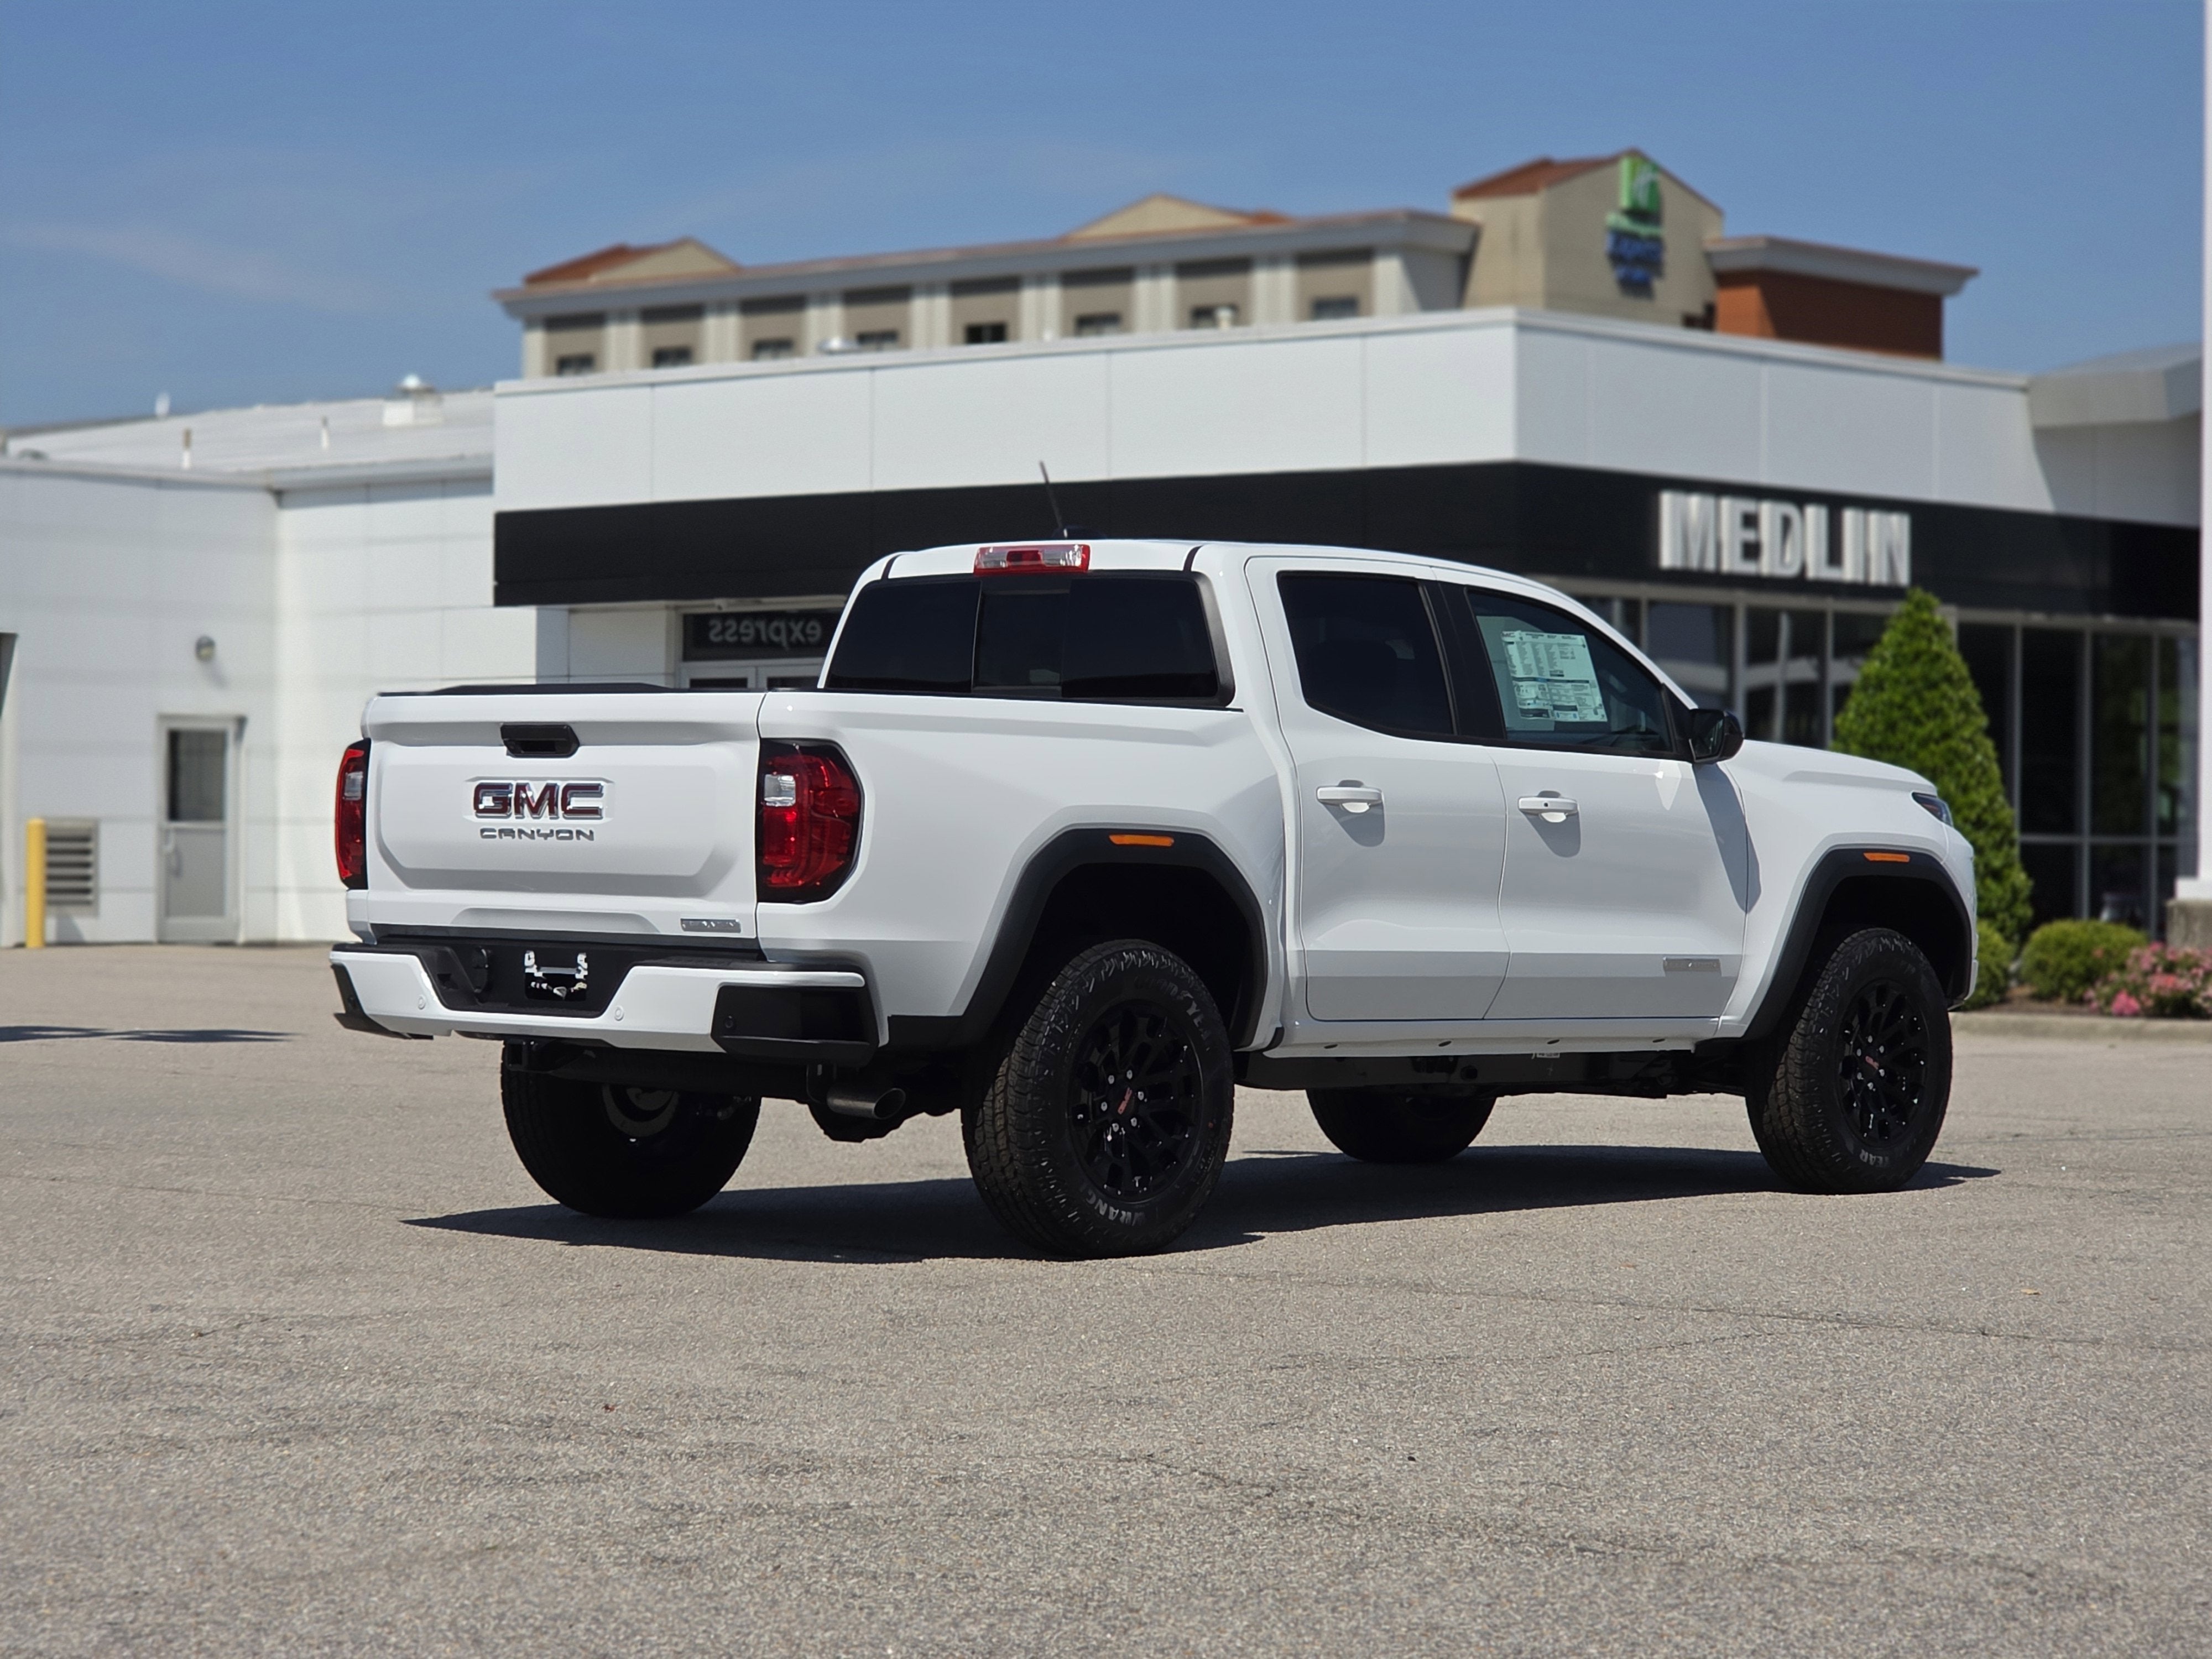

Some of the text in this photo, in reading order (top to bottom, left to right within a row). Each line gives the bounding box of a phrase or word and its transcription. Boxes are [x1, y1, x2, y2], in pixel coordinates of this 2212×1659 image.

[1660, 490, 1911, 587] MEDLIN
[473, 780, 604, 820] GMC
[479, 827, 594, 841] CANYON
